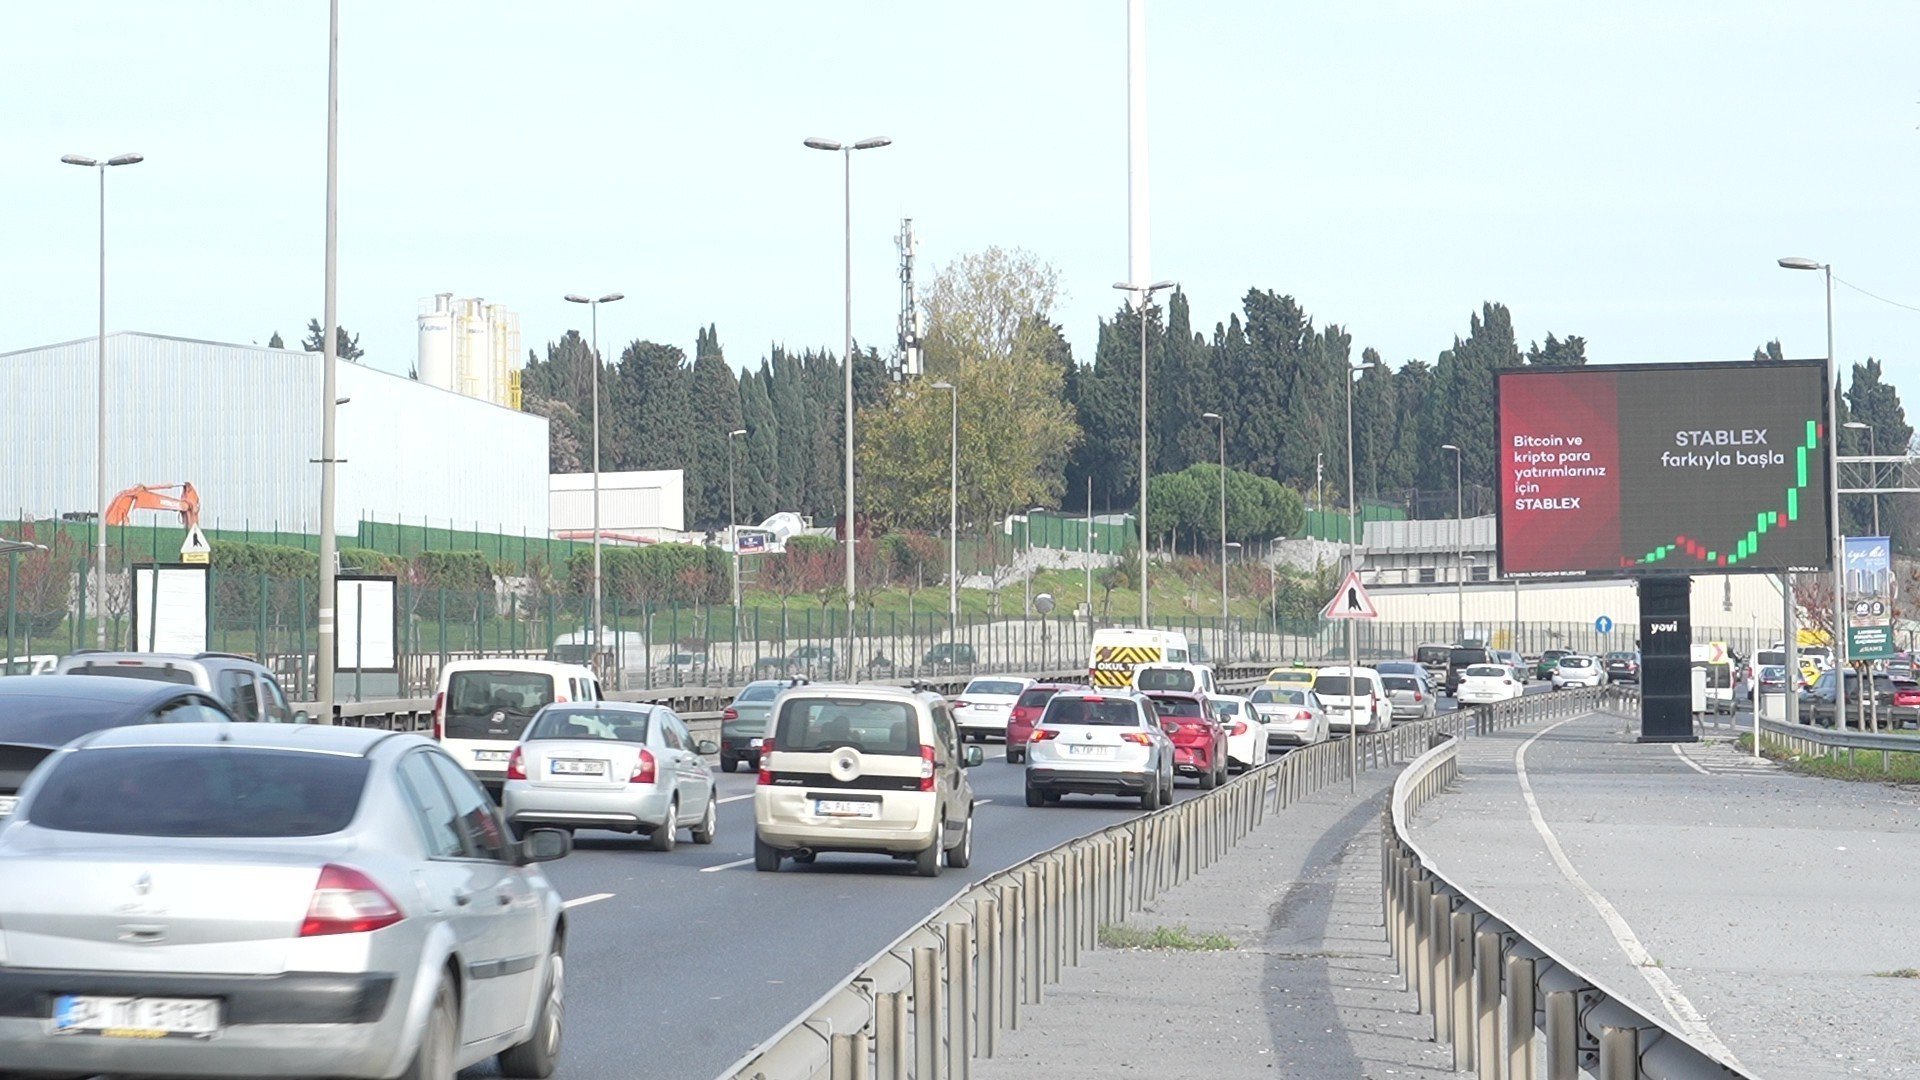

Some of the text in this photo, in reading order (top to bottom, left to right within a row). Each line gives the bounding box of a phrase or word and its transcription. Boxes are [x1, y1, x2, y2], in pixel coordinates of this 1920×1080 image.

[1514, 435, 1583, 447] Bitcoin ve
[1676, 429, 1767, 446] STABLEX
[1514, 450, 1591, 465] kripto para
[1661, 450, 1785, 470] farkıyla başla
[1515, 465, 1606, 480] yatırımlarınız
[1515, 482, 1540, 495] için
[1515, 498, 1580, 510] STABLEX
[1650, 620, 1678, 635] yovi
[1097, 663, 1125, 671] OKUL
